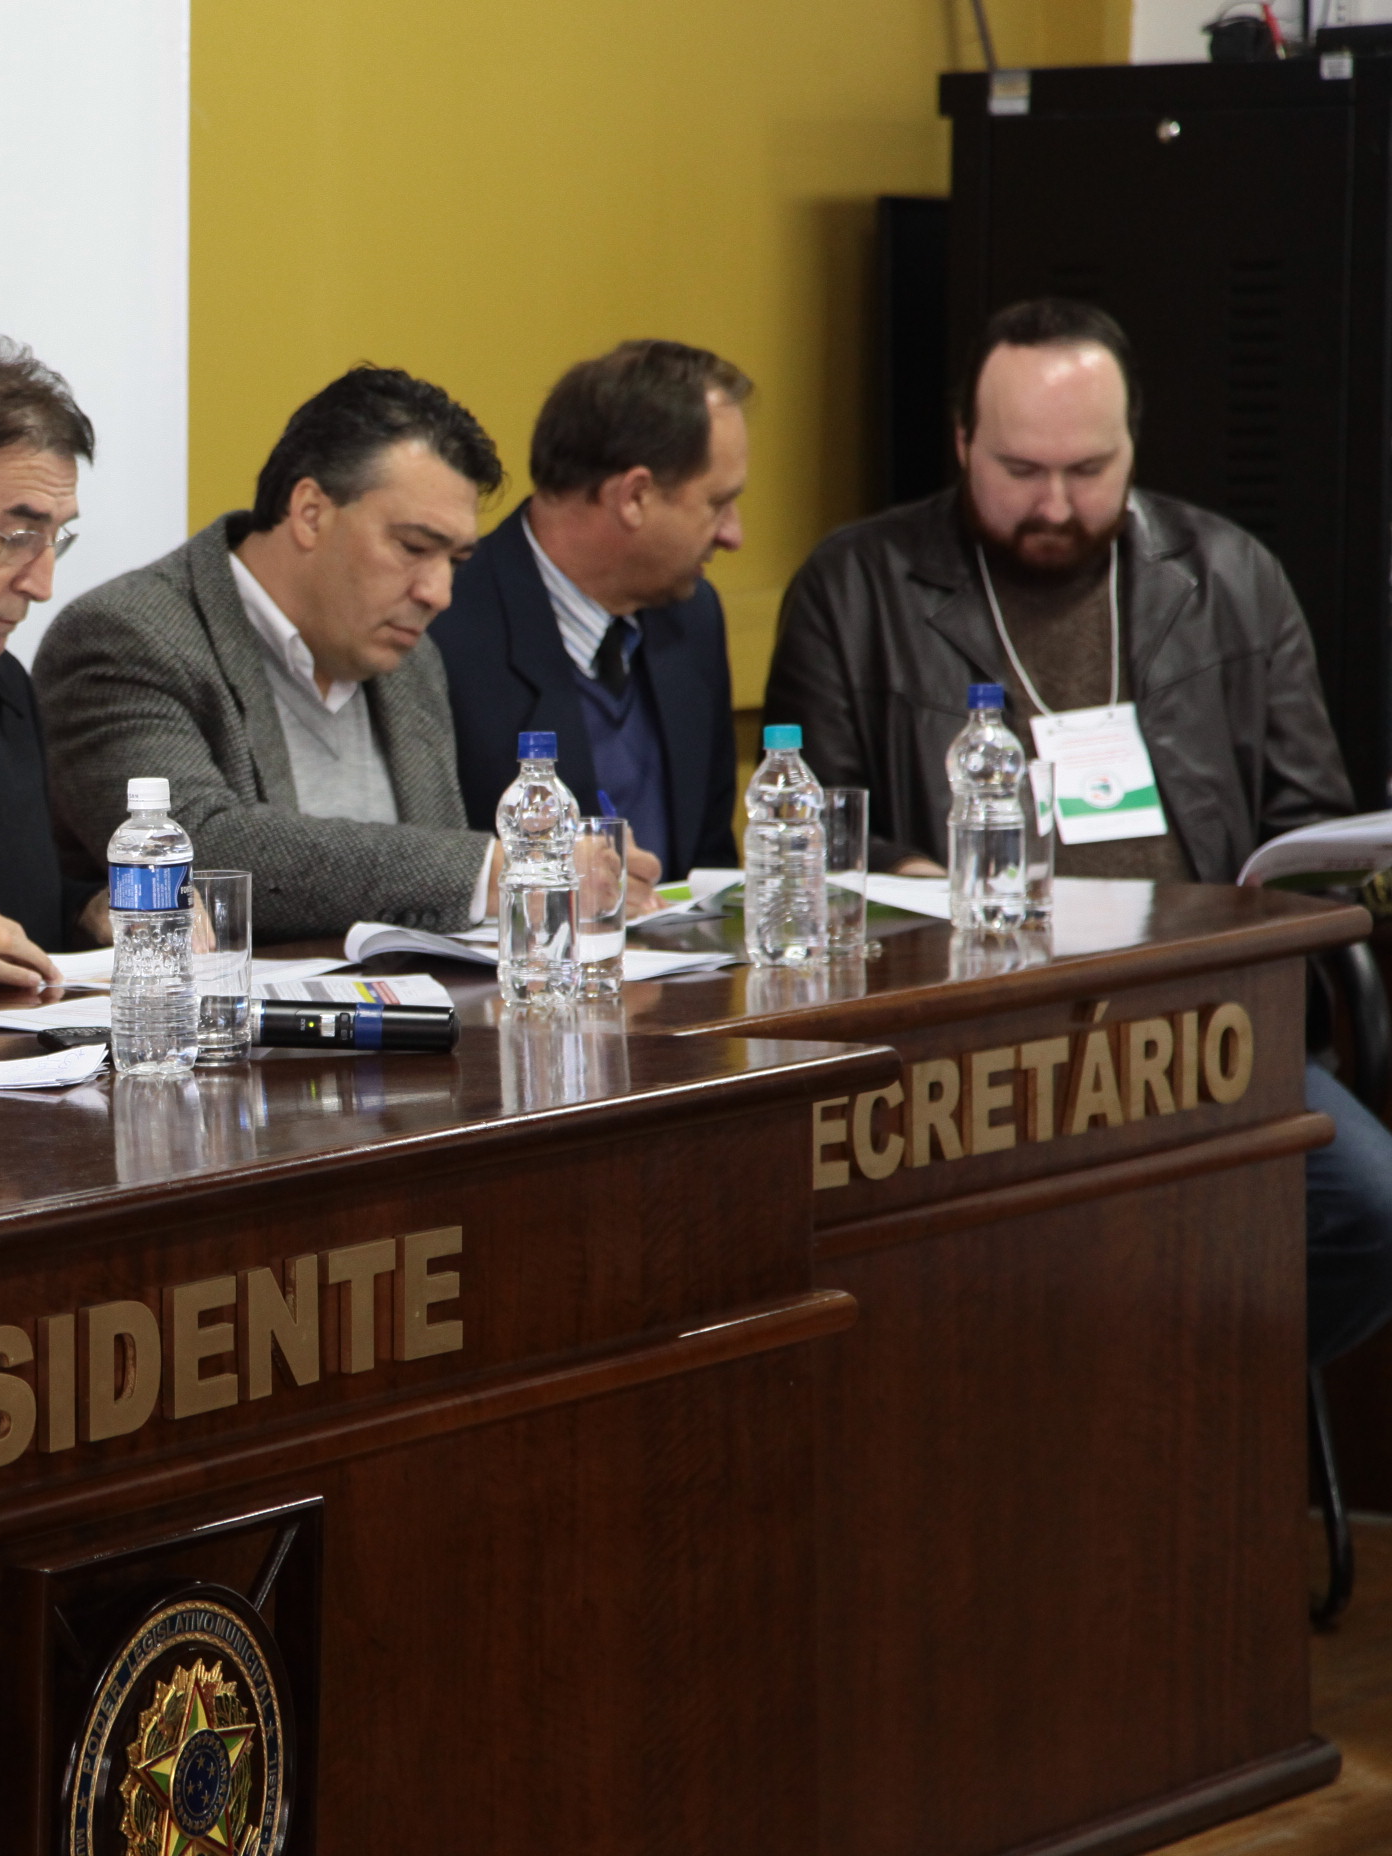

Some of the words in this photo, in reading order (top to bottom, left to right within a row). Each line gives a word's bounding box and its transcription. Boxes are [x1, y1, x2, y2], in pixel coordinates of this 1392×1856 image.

[82, 1680, 124, 1775] PODER
[126, 1611, 215, 1676] LEGISLATIVO
[214, 1616, 272, 1716] MUNICIPAL
